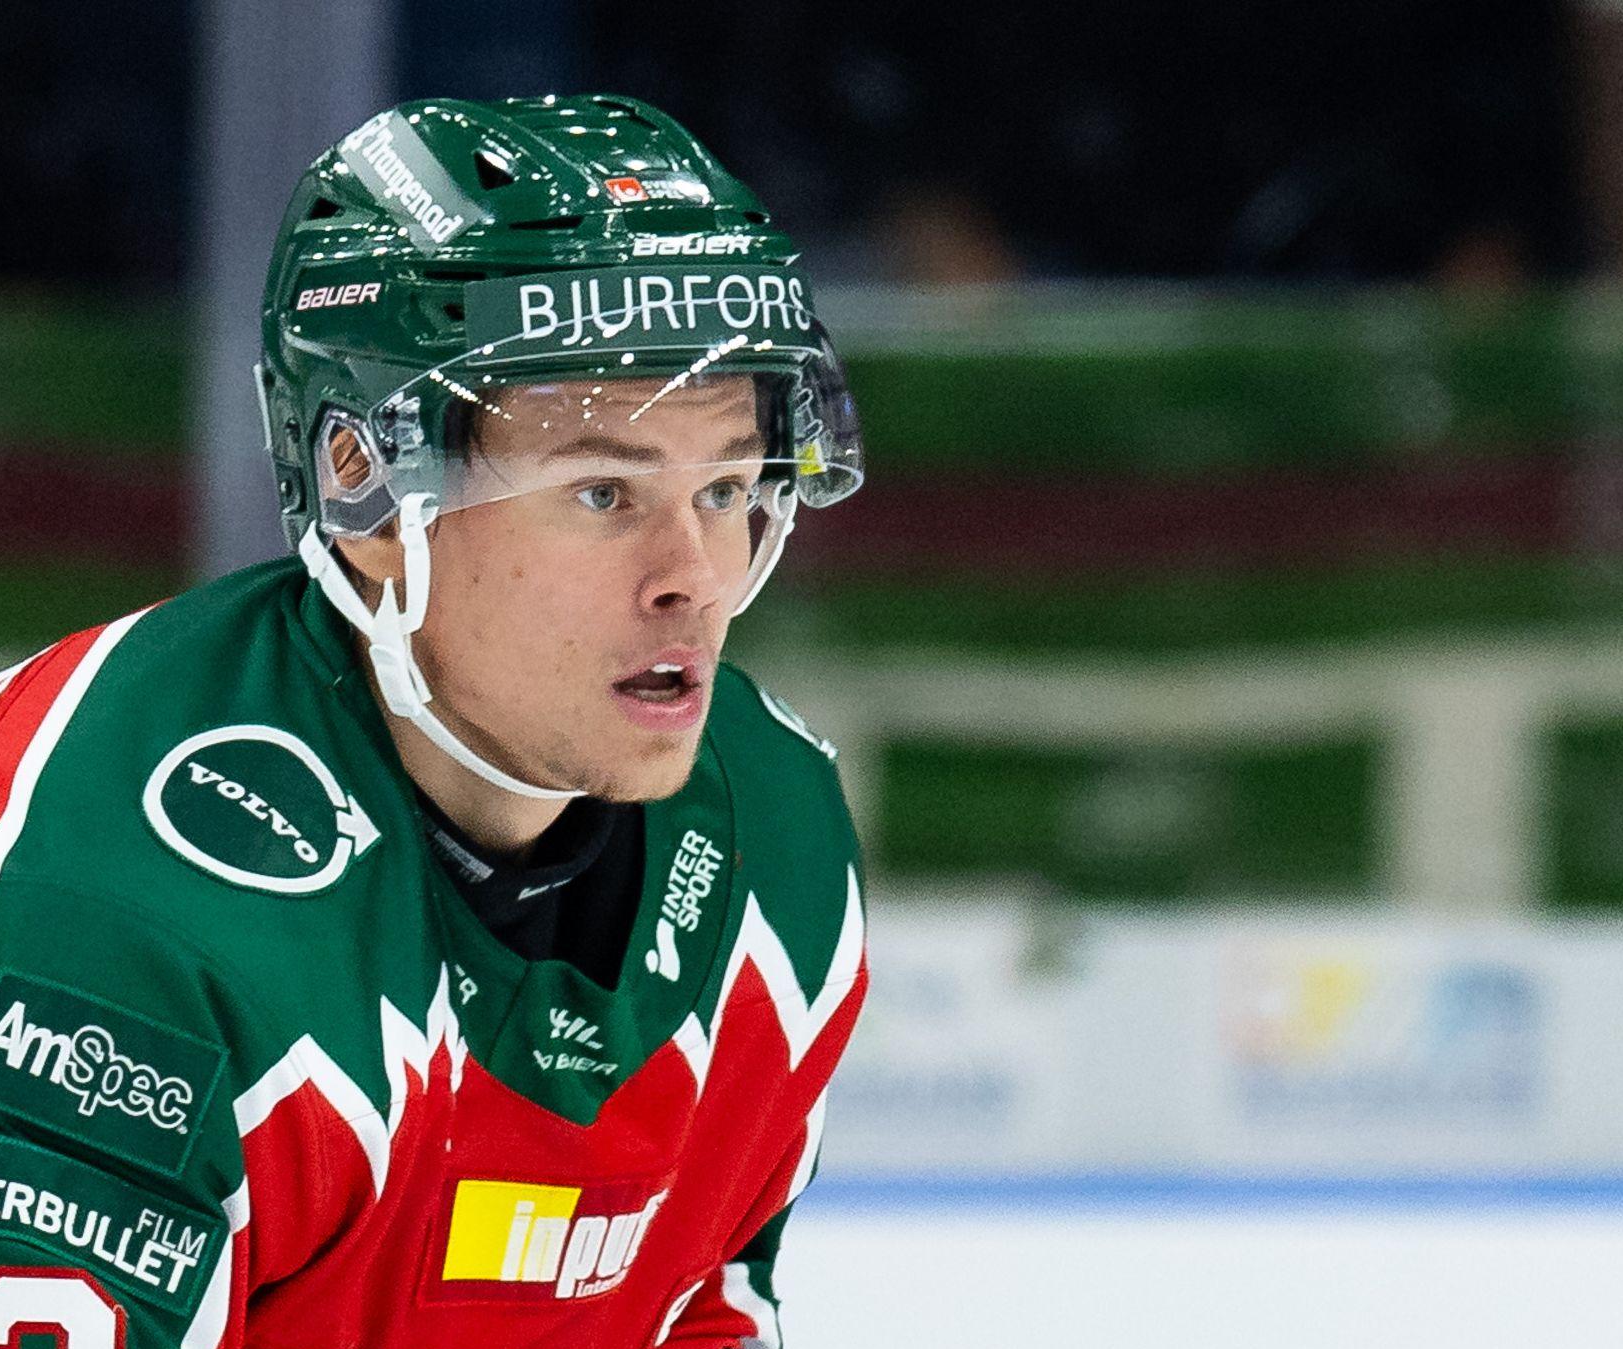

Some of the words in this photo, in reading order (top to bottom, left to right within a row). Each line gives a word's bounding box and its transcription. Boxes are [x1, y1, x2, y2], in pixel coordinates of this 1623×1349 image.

[519, 274, 811, 347] BJURFORS
[187, 761, 319, 864] VOLVO
[661, 829, 707, 920] INTER
[676, 839, 724, 932] SPORT
[134, 1207, 209, 1261] FILM
